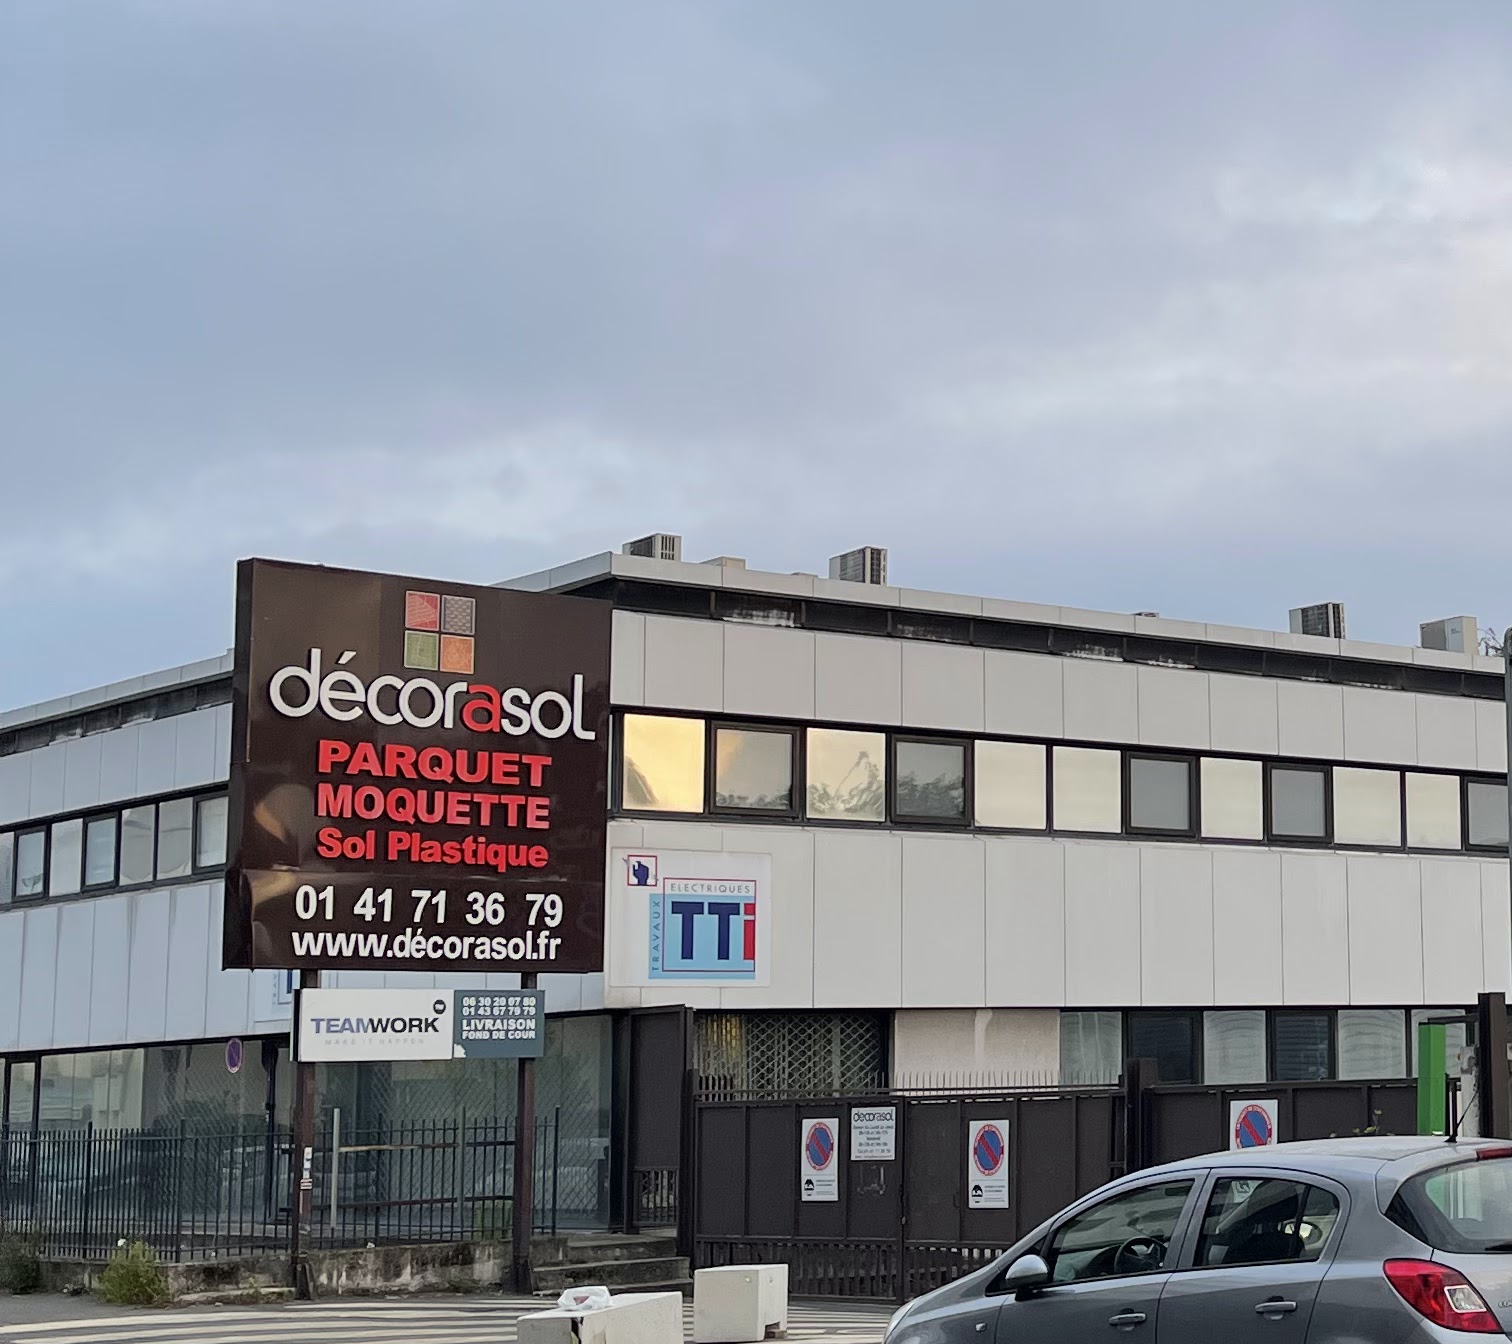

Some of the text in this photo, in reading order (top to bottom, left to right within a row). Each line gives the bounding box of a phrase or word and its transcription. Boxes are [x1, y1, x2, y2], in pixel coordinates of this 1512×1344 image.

[269, 647, 596, 741] décorasol
[318, 739, 552, 788] PARQUET
[316, 783, 551, 830] MOQUETTE
[317, 828, 549, 872] Sol Plastique
[295, 885, 564, 928] 01 41 71 36 79
[670, 883, 751, 894] ELECTRIQUES
[292, 928, 562, 961] www.décorasol.fr
[651, 900, 661, 971] TRAVAUX
[310, 1017, 440, 1034] TEAMWORK
[461, 1018, 536, 1030] LIVRAISON
[462, 1007, 476, 1016] 01
[477, 1007, 492, 1016] 43
[461, 1030, 536, 1040] FOND DE COUR
